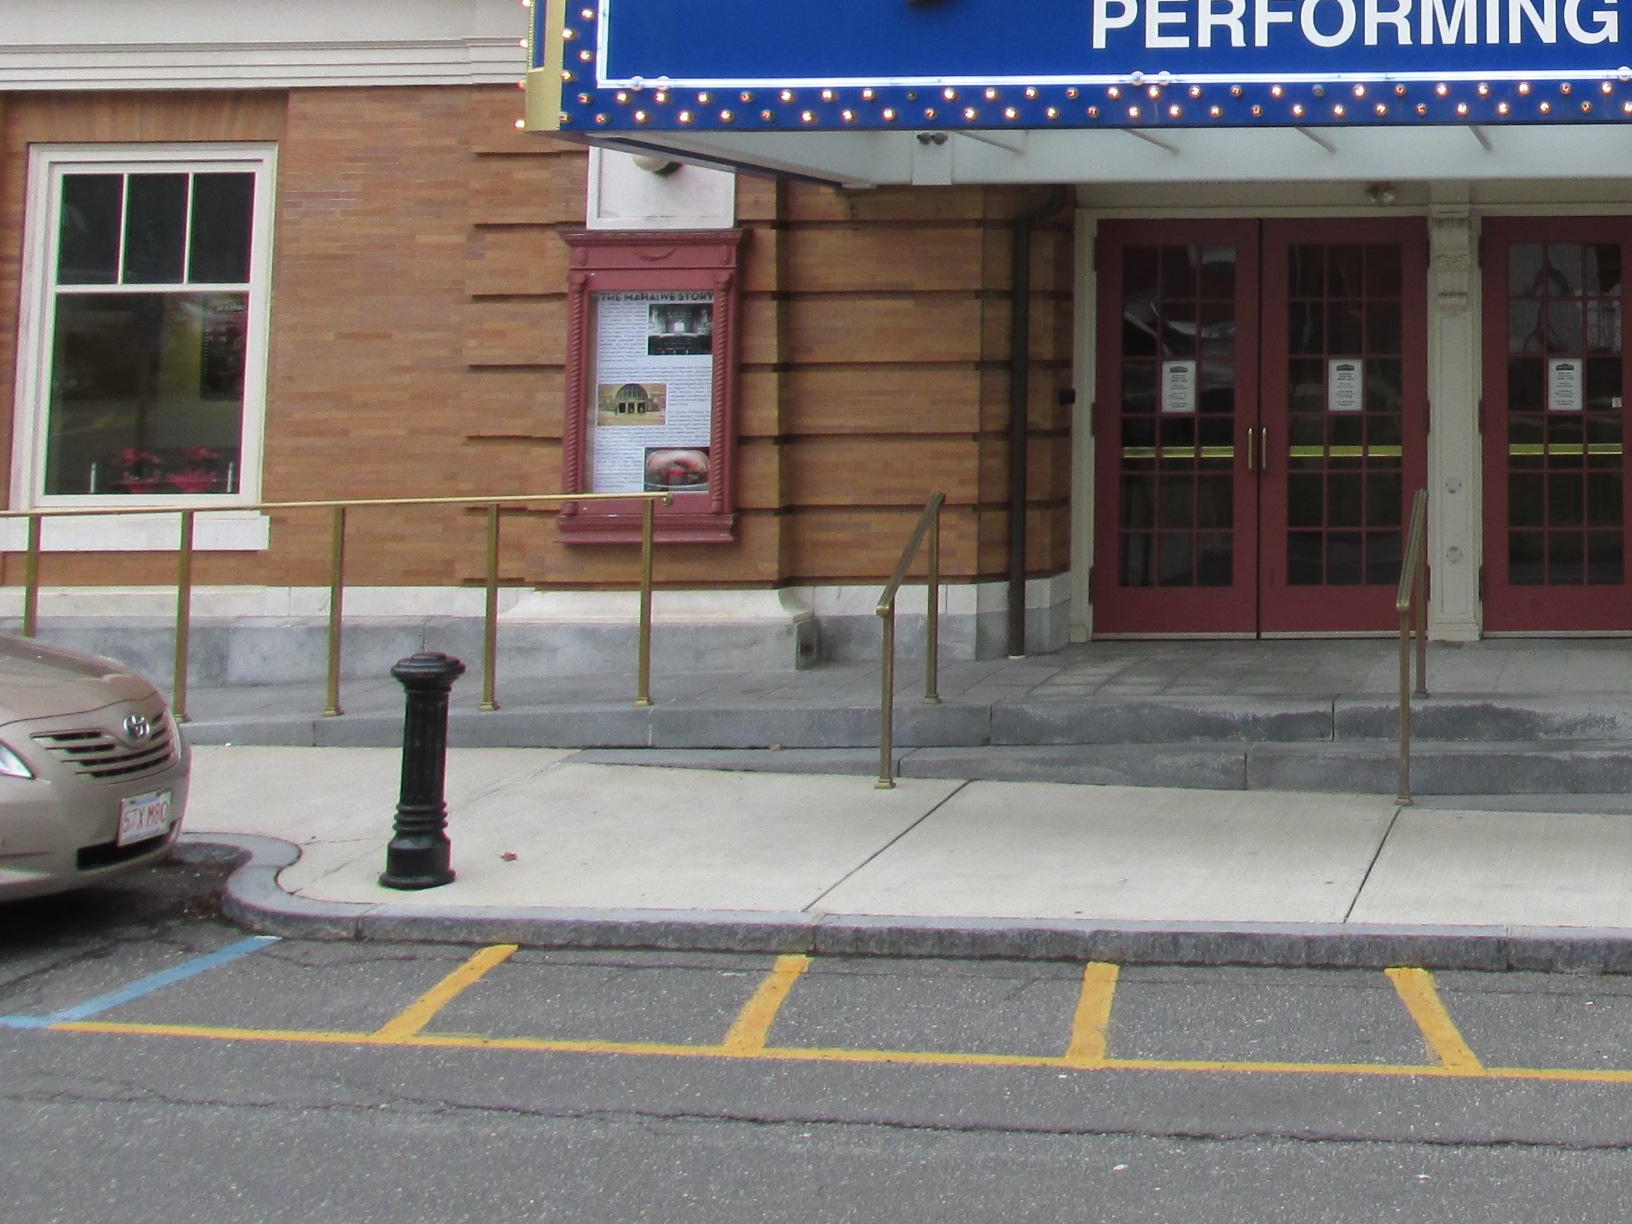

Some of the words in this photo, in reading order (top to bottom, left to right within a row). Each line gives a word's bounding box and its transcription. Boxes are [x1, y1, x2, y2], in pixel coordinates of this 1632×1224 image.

[600, 292, 622, 302] THE
[623, 292, 676, 302] MAHAIWE
[677, 291, 714, 302] STORY
